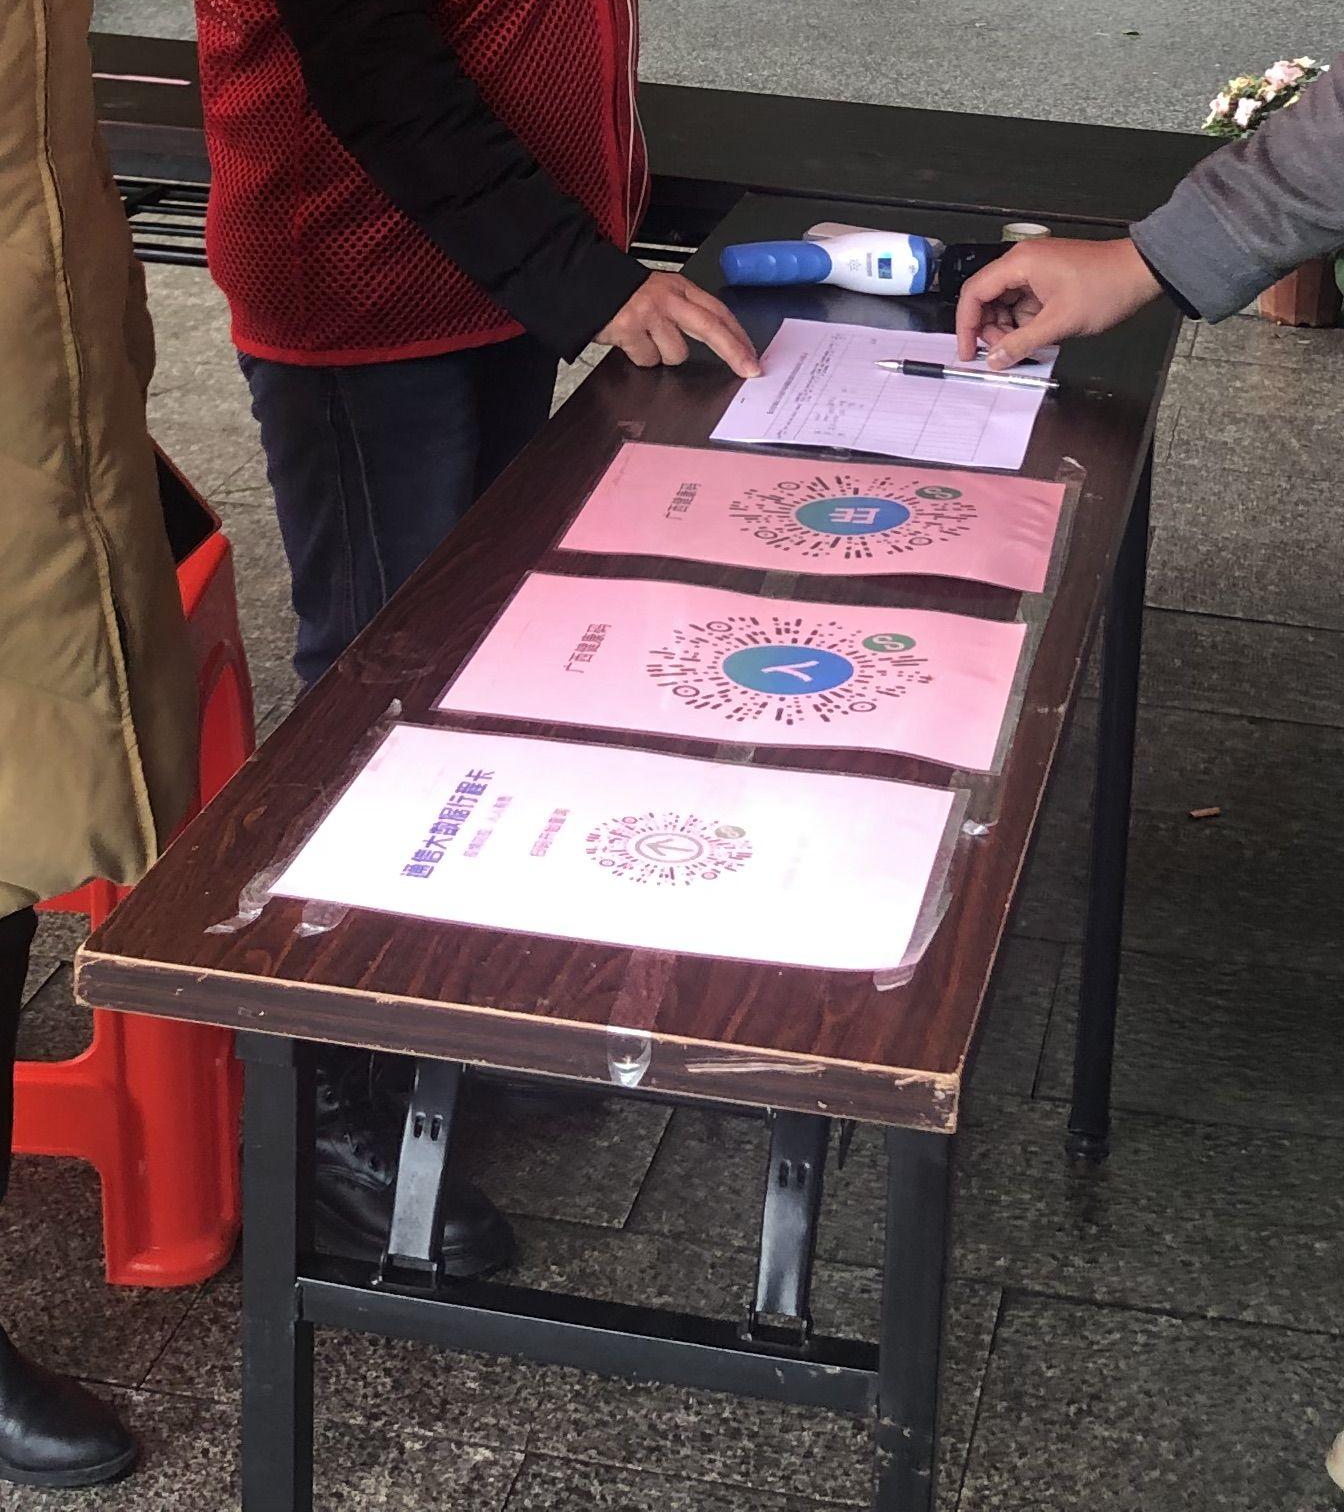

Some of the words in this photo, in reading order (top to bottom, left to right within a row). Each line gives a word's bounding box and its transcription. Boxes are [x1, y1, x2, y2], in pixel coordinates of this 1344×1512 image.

[562, 622, 613, 674] 广西健康码
[400, 768, 496, 879] 通信大数据行程卡
